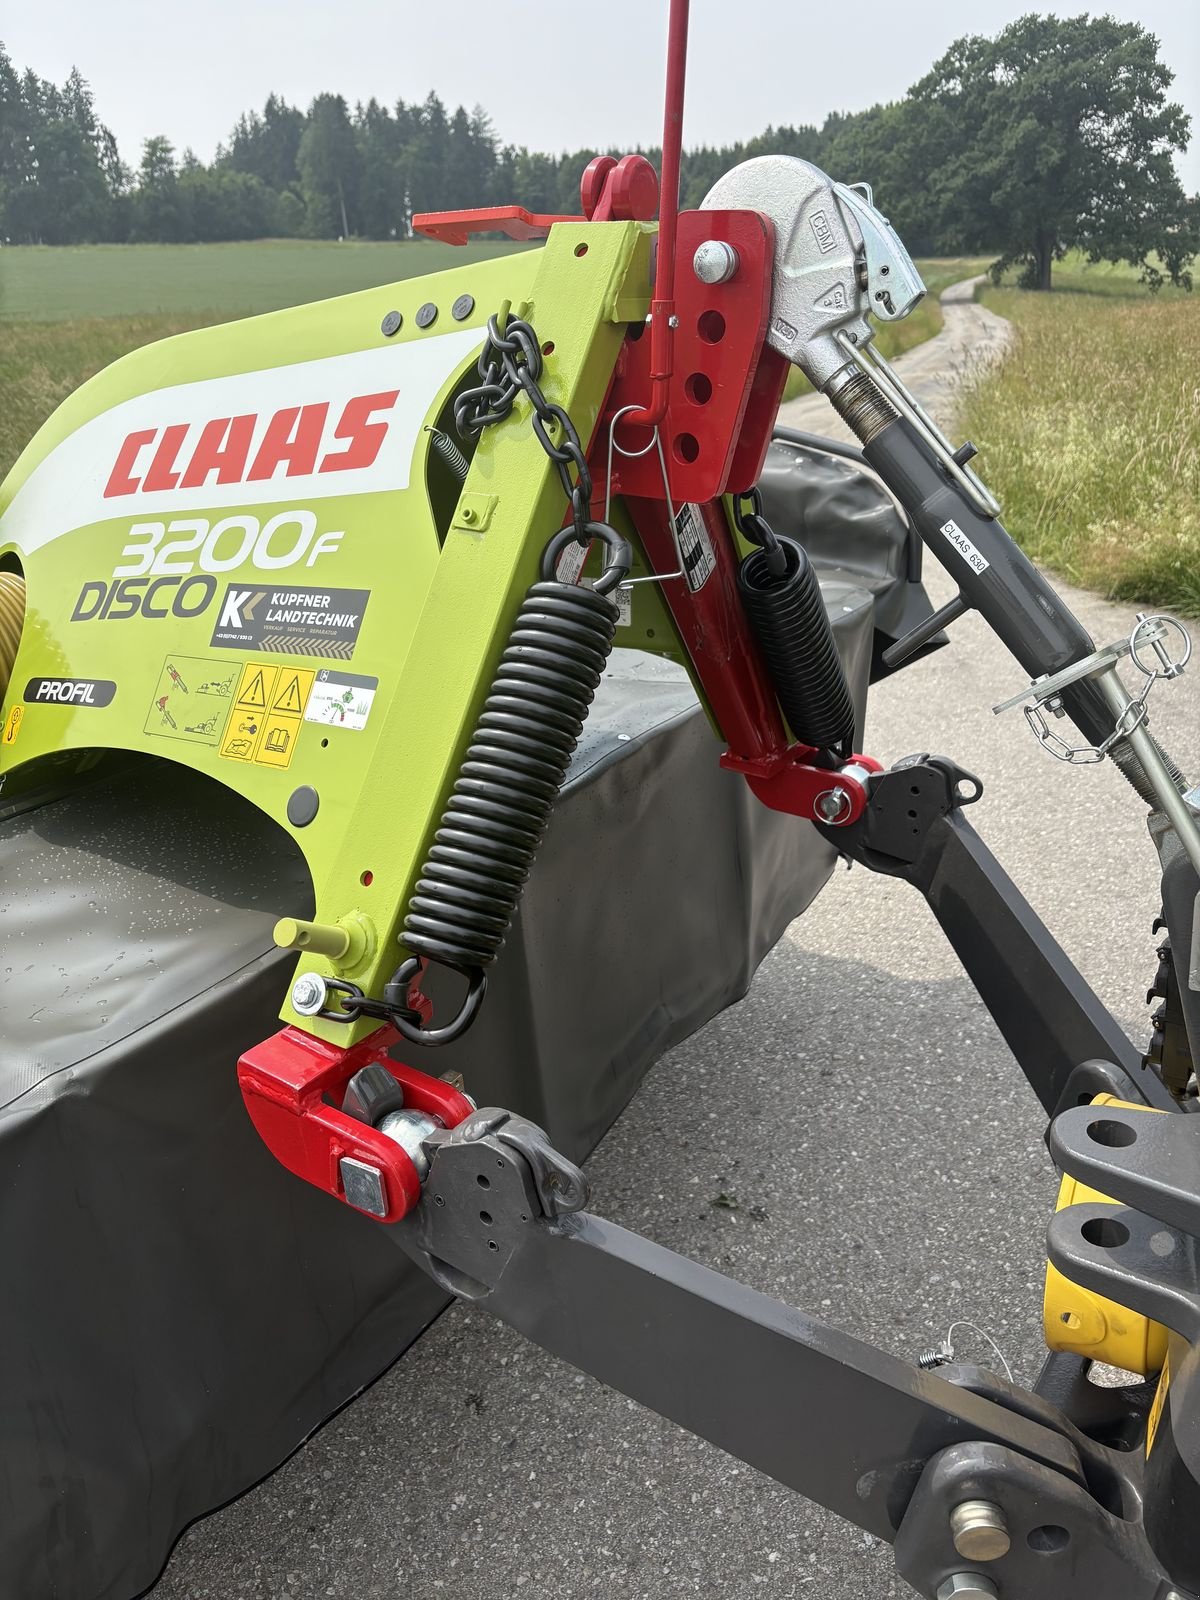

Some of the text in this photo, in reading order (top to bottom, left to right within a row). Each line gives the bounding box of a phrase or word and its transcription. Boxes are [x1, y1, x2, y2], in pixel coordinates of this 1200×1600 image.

[813, 216, 833, 249] CBM
[103, 390, 400, 498] CLAAS
[944, 524, 986, 571] CLAAS 630
[70, 575, 217, 622] DISCO
[271, 592, 331, 609] KUPFNER
[265, 609, 359, 628] LANDTECHNIK
[36, 681, 95, 703] PROFIL
